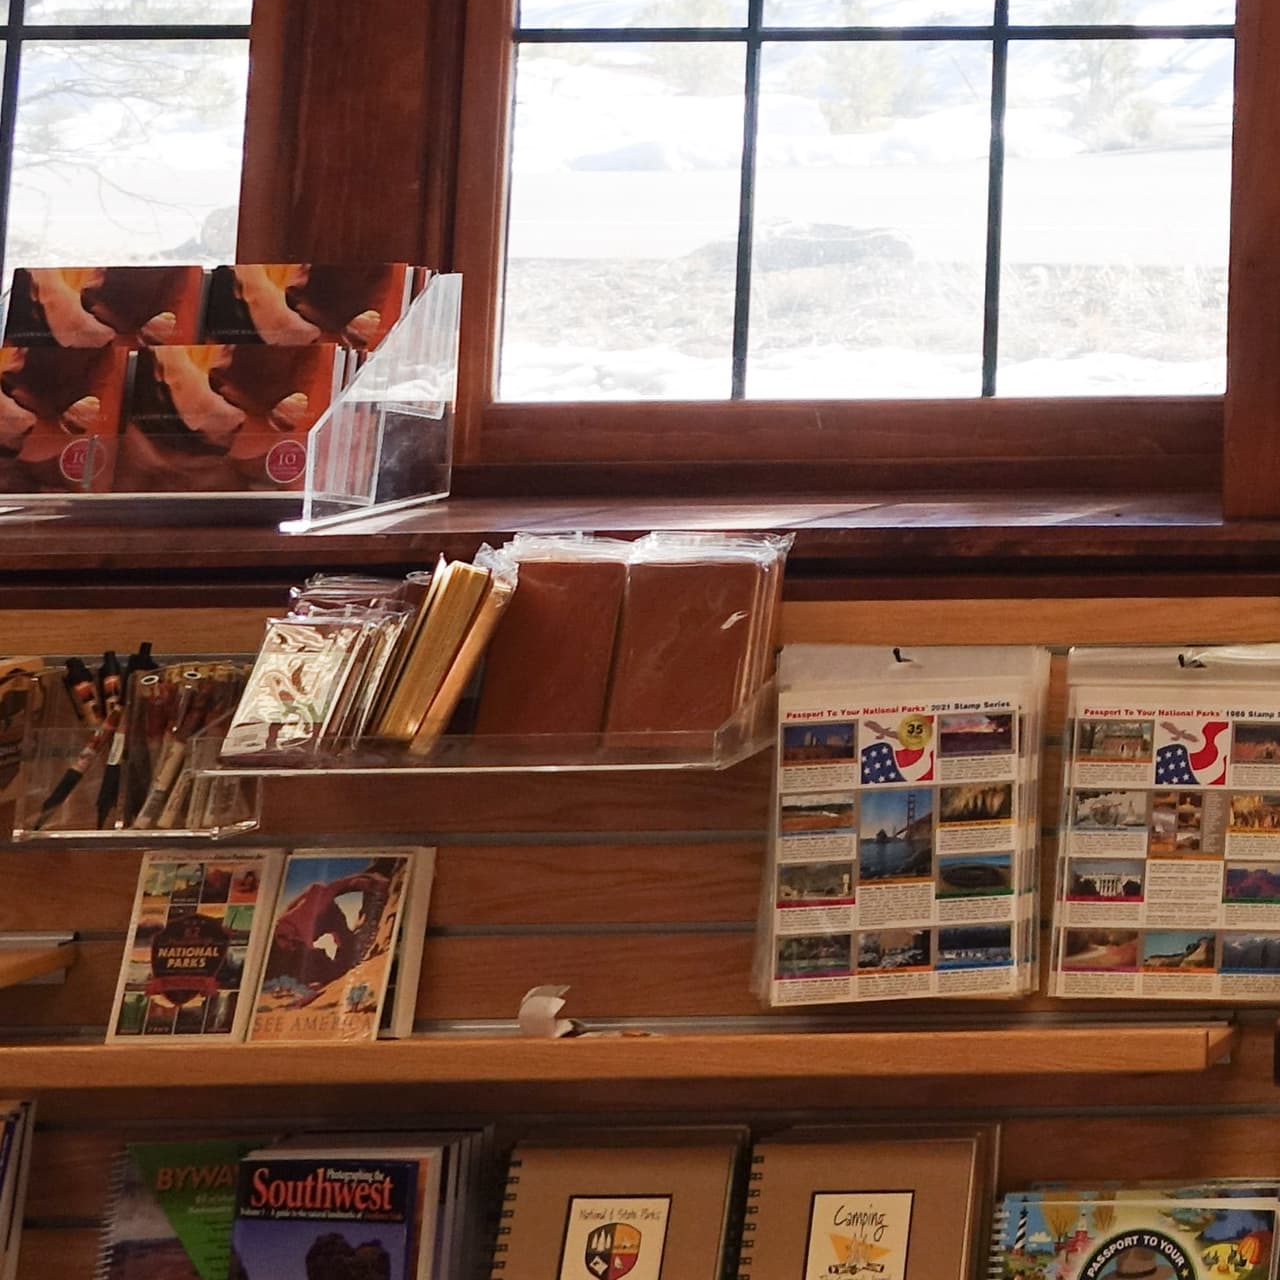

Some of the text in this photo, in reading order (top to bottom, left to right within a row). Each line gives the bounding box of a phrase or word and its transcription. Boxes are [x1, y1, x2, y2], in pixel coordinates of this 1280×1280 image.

[786, 710, 824, 720] Passport
[840, 708, 860, 716] Your
[862, 706, 900, 715] National
[931, 703, 951, 712] 2021
[953, 702, 982, 710] Stamp
[983, 700, 1010, 709] Series
[1084, 708, 1121, 717] Passport
[1137, 708, 1157, 716] Your
[1158, 709, 1194, 717] National
[1248, 710, 1275, 719] Stamp
[906, 723, 924, 736] 35
[158, 946, 220, 958] NATIONAL
[166, 957, 207, 969] PARKS
[254, 1014, 372, 1032] SEE AMERICA
[250, 1166, 396, 1211] Southwest
[579, 1208, 607, 1221] National
[617, 1207, 637, 1220] State
[640, 1207, 661, 1221] Parks
[833, 1203, 889, 1242] Camping
[1086, 1234, 1186, 1278] PASSPORT TO YOUR
